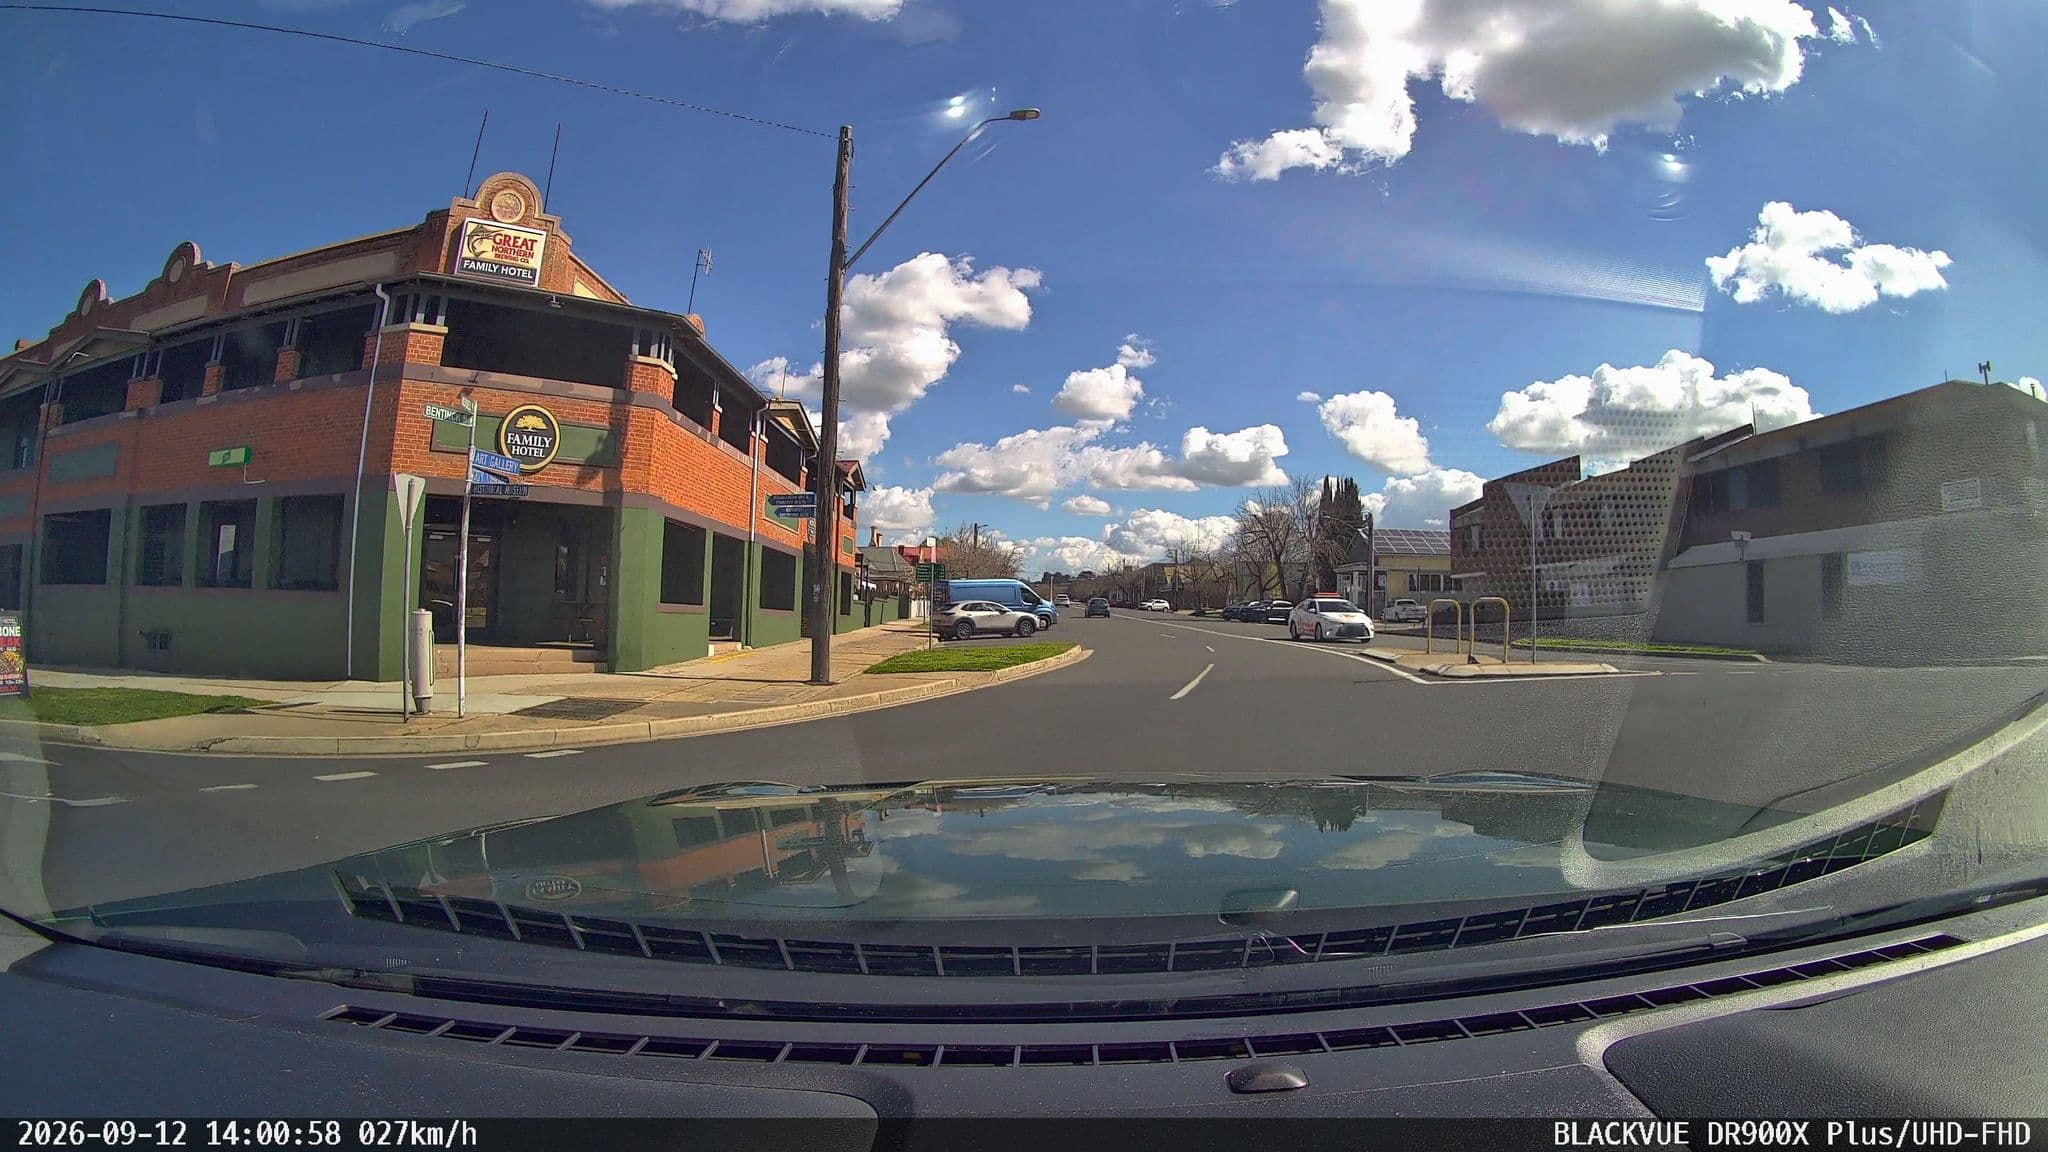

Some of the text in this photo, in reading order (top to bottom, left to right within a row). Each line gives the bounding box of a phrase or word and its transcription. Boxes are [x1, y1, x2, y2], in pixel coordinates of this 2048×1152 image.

[493, 233, 537, 251] GREAT
[492, 245, 534, 259] NORTHERN
[463, 260, 533, 279] FAMILY HOTEL
[507, 432, 552, 448] FAMILY
[511, 445, 545, 458] HOTEL
[474, 452, 519, 473] ART GALLERY
[0, 626, 21, 637] ONE
